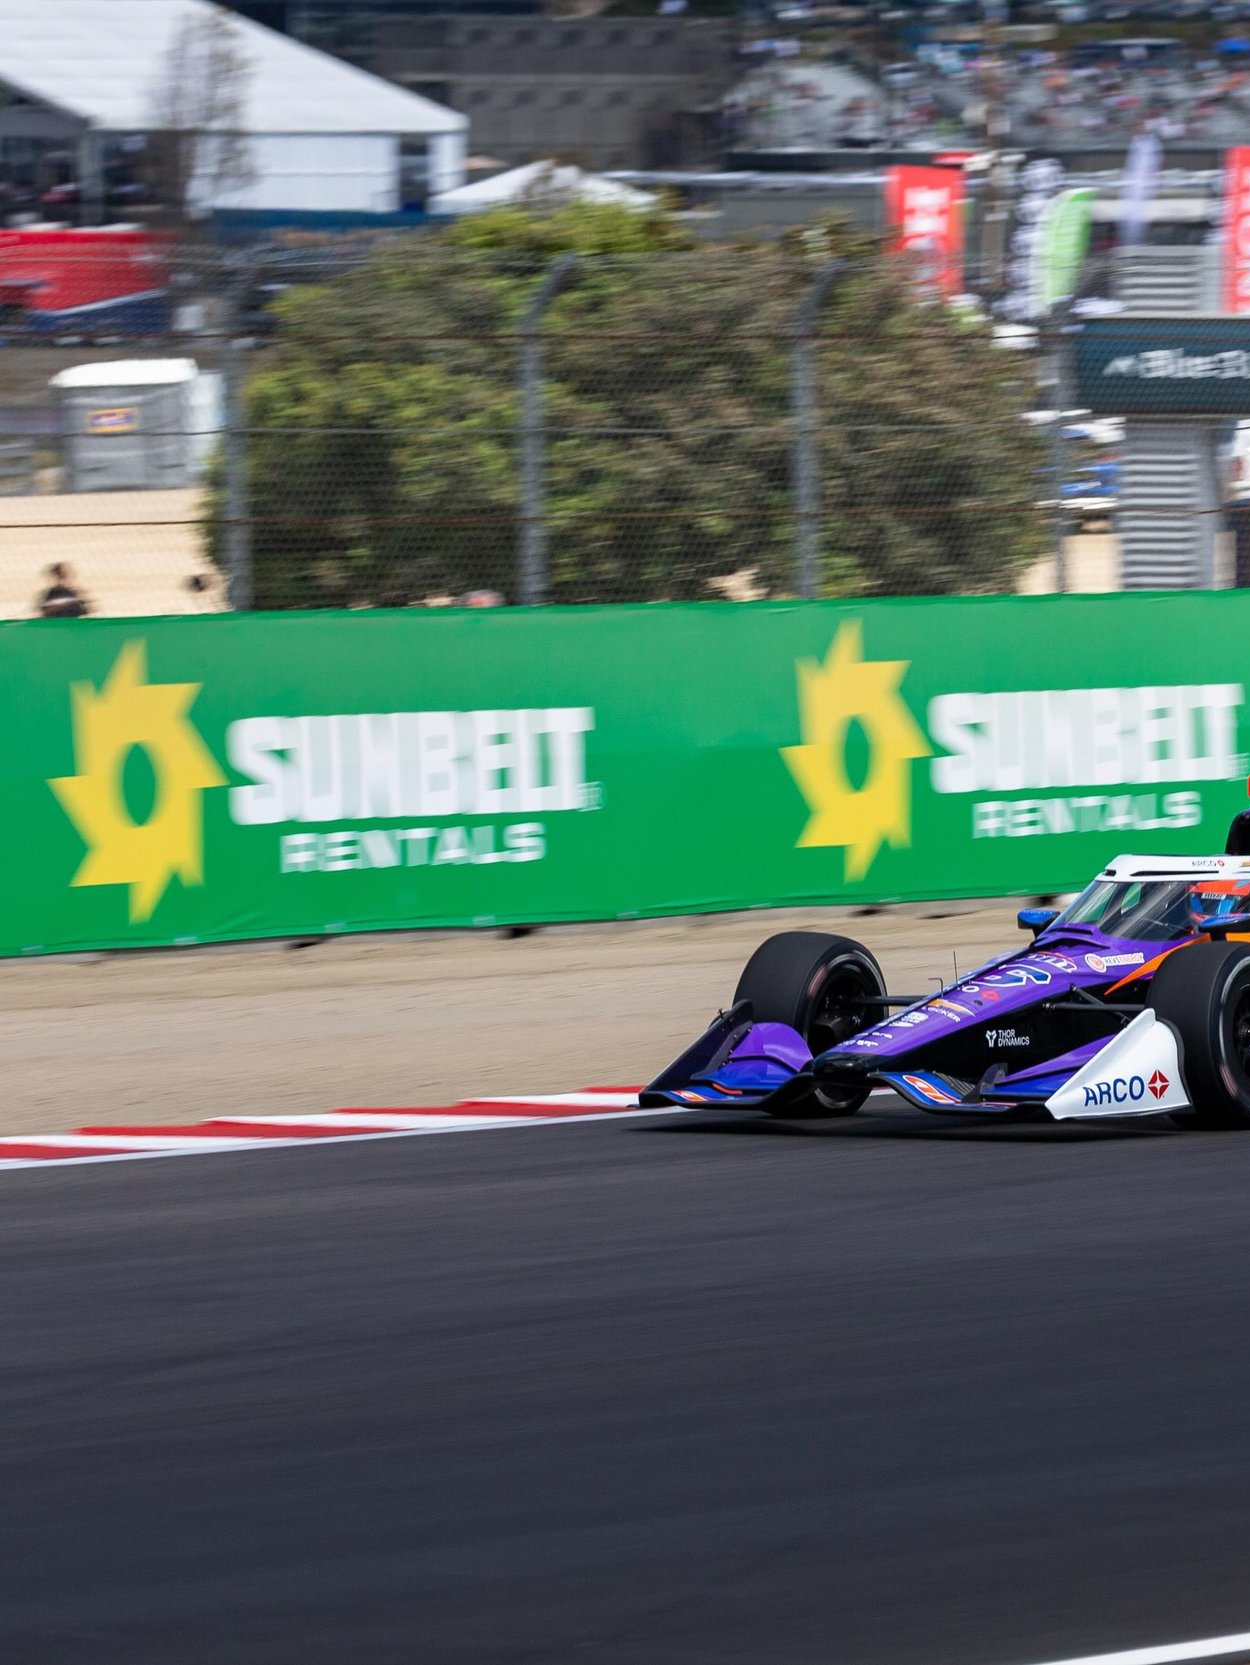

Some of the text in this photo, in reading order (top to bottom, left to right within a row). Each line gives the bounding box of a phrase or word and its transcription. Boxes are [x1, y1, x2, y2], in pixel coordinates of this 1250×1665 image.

[927, 683, 1245, 794] SUNBELT
[226, 707, 596, 825] SUNBELT
[973, 791, 1202, 839] RENTALS
[280, 822, 546, 873] RENTALS
[998, 1029, 1016, 1039] THOR
[998, 1036, 1030, 1047] DYNAMICS
[1083, 1075, 1145, 1107] ARCO
